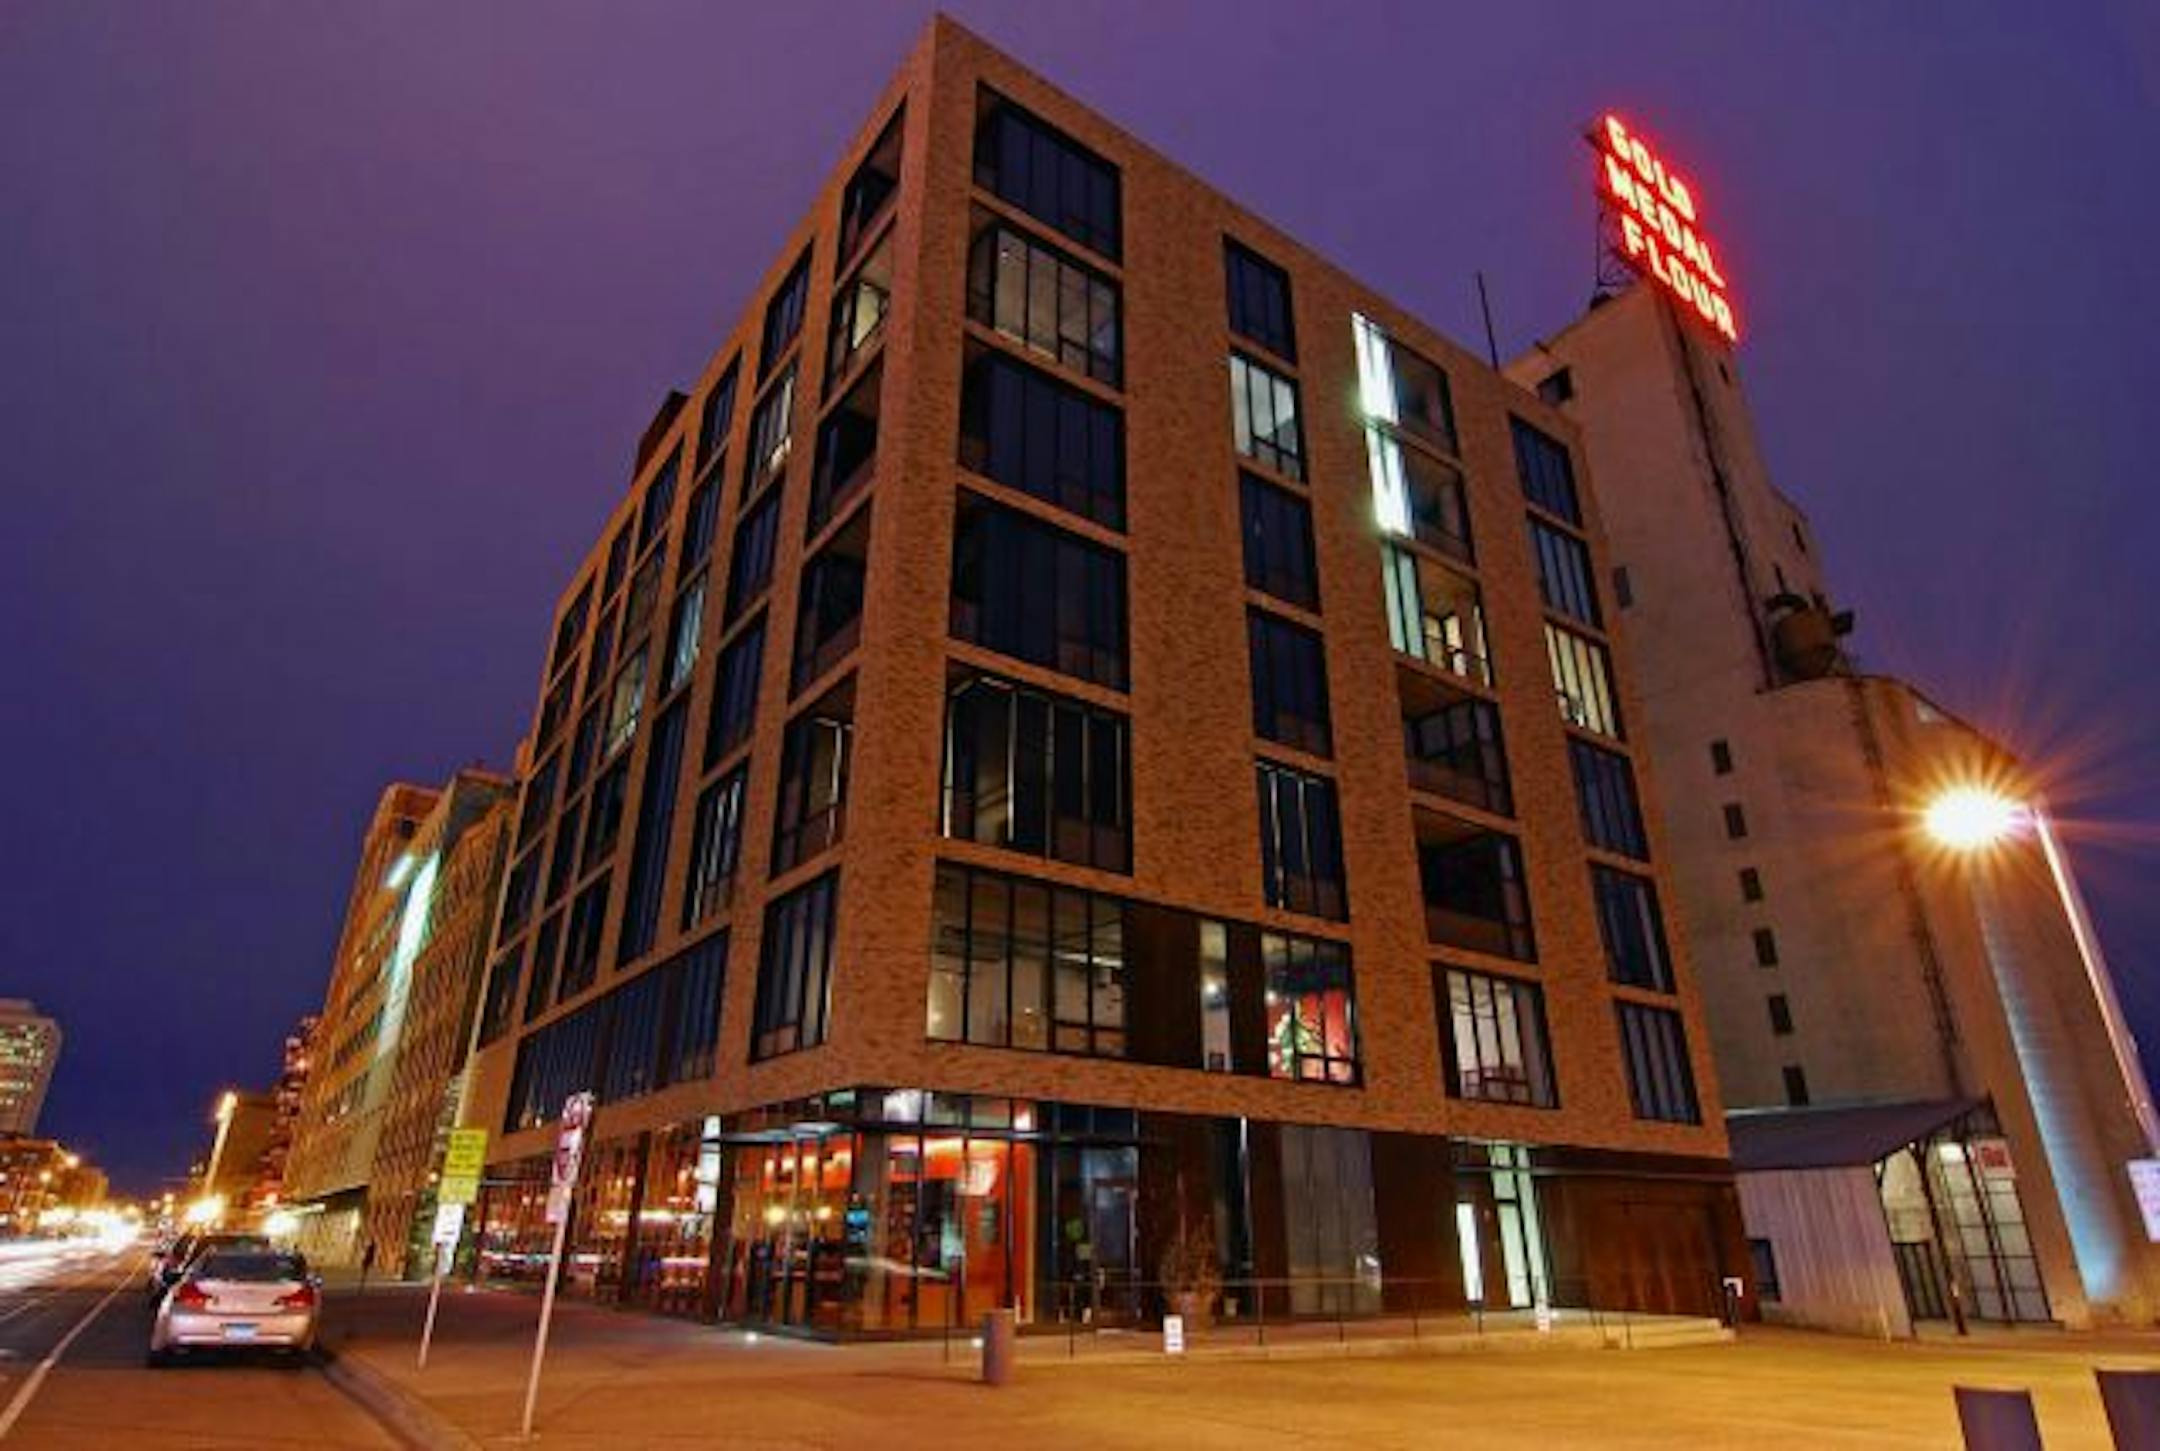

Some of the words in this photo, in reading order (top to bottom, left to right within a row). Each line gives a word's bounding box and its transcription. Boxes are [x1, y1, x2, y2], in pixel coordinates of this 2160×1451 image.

[1604, 153, 1726, 288] MEDAL
[1605, 115, 1696, 222] GOLD
[1621, 214, 1736, 341] FLOUR
